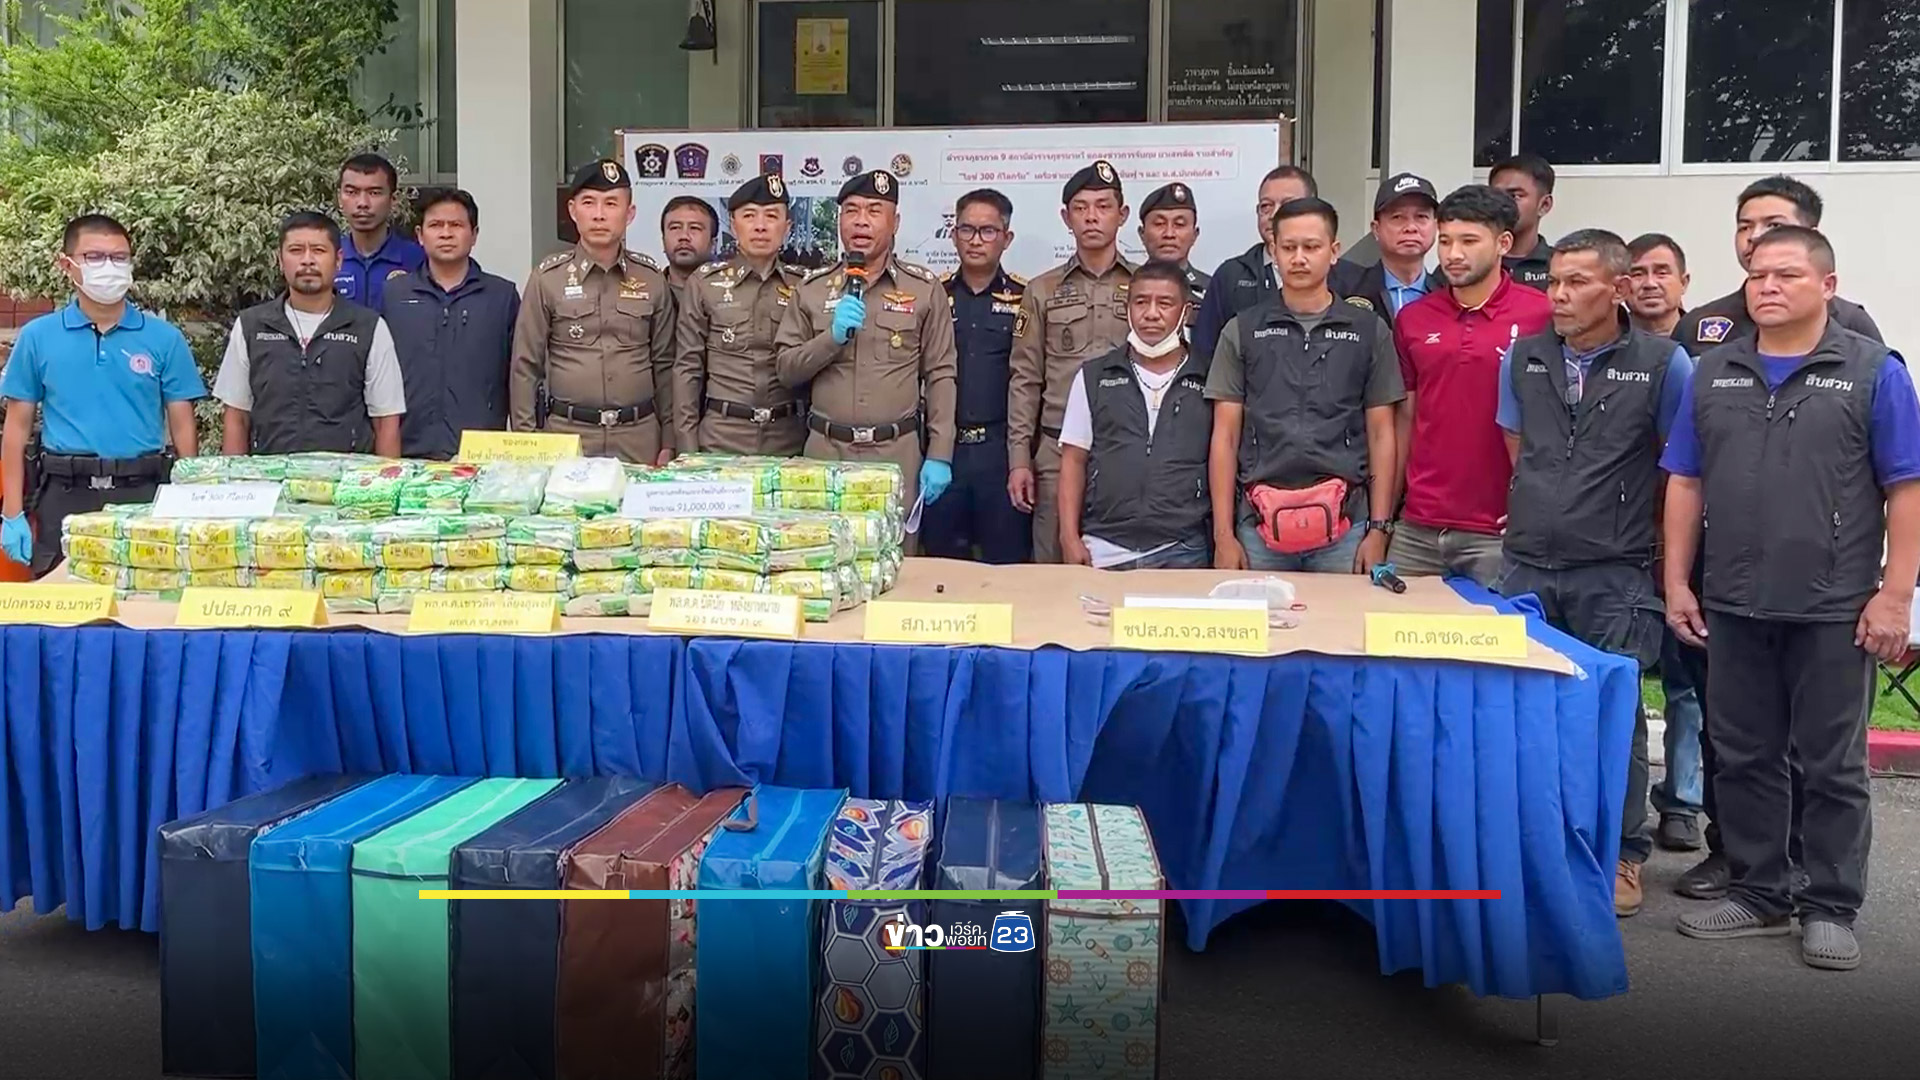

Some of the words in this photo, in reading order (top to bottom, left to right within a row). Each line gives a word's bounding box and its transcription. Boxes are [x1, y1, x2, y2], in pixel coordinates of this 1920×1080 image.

[979, 172, 995, 181] 300
[1324, 328, 1360, 342] สืบสวน
[1607, 368, 1650, 382] สืบสวน
[1805, 373, 1854, 391] สืบสวน
[676, 502, 726, 512] 91,000,000
[0, 596, 51, 610] ปกครอง
[56, 597, 103, 611] อ.นาทวี
[202, 601, 273, 618] ปปส.ภาค
[278, 605, 294, 618] ๙
[901, 612, 978, 634] สภ.นาทวี
[1124, 622, 1259, 641] ชปส.ภ.จว.สงขลา
[1394, 630, 1499, 646] กก.ตชด.๔๓
